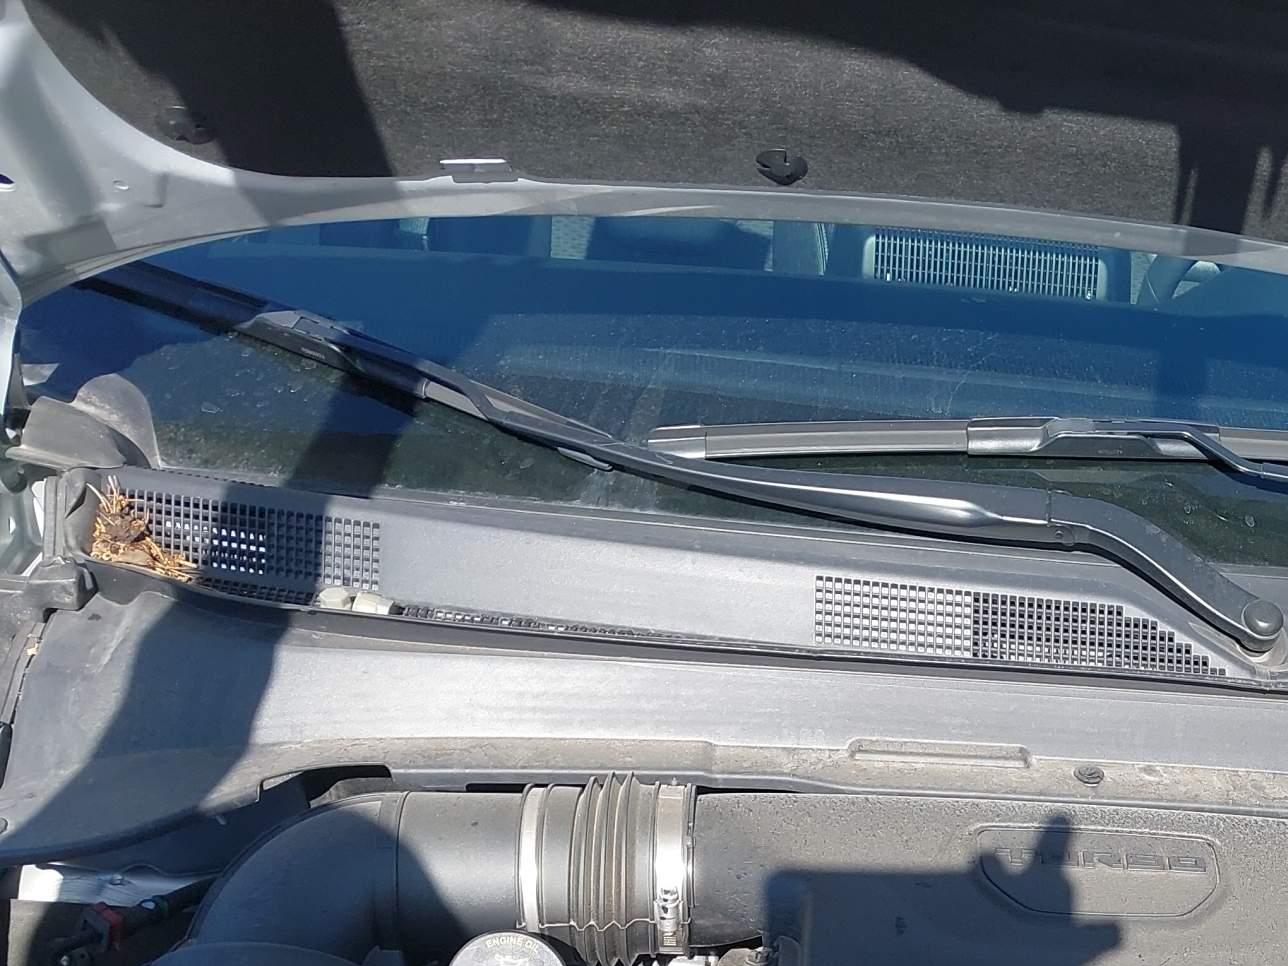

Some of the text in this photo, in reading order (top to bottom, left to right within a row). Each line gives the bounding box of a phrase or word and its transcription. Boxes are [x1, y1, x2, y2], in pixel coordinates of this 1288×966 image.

[994, 847, 1206, 873] TURBO
[485, 935, 540, 953] ENGINE OIL
